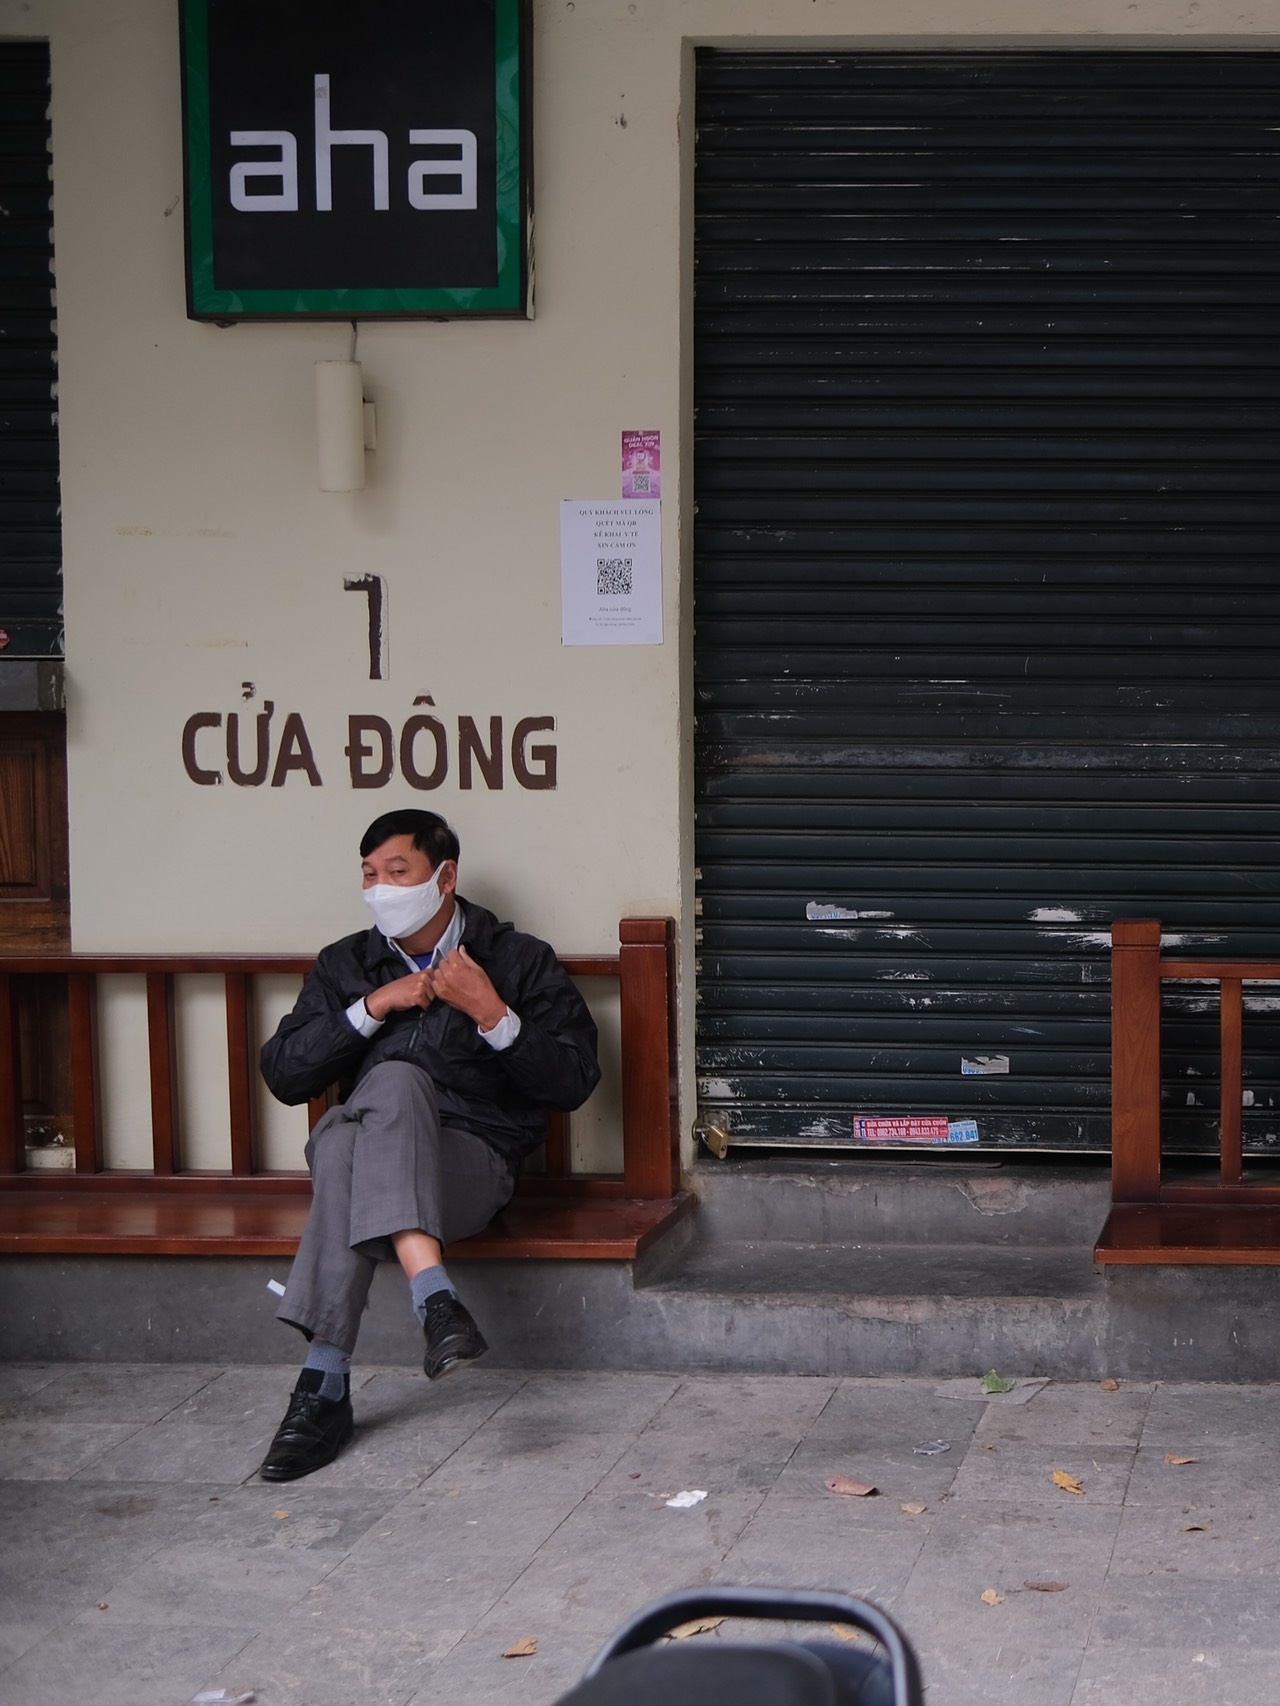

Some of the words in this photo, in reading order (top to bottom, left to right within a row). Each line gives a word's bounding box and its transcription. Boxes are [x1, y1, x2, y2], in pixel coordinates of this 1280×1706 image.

[229, 73, 478, 212] aha
[343, 572, 389, 680] 1
[182, 682, 324, 787] CỬA
[345, 689, 559, 791] ĐÔNG
